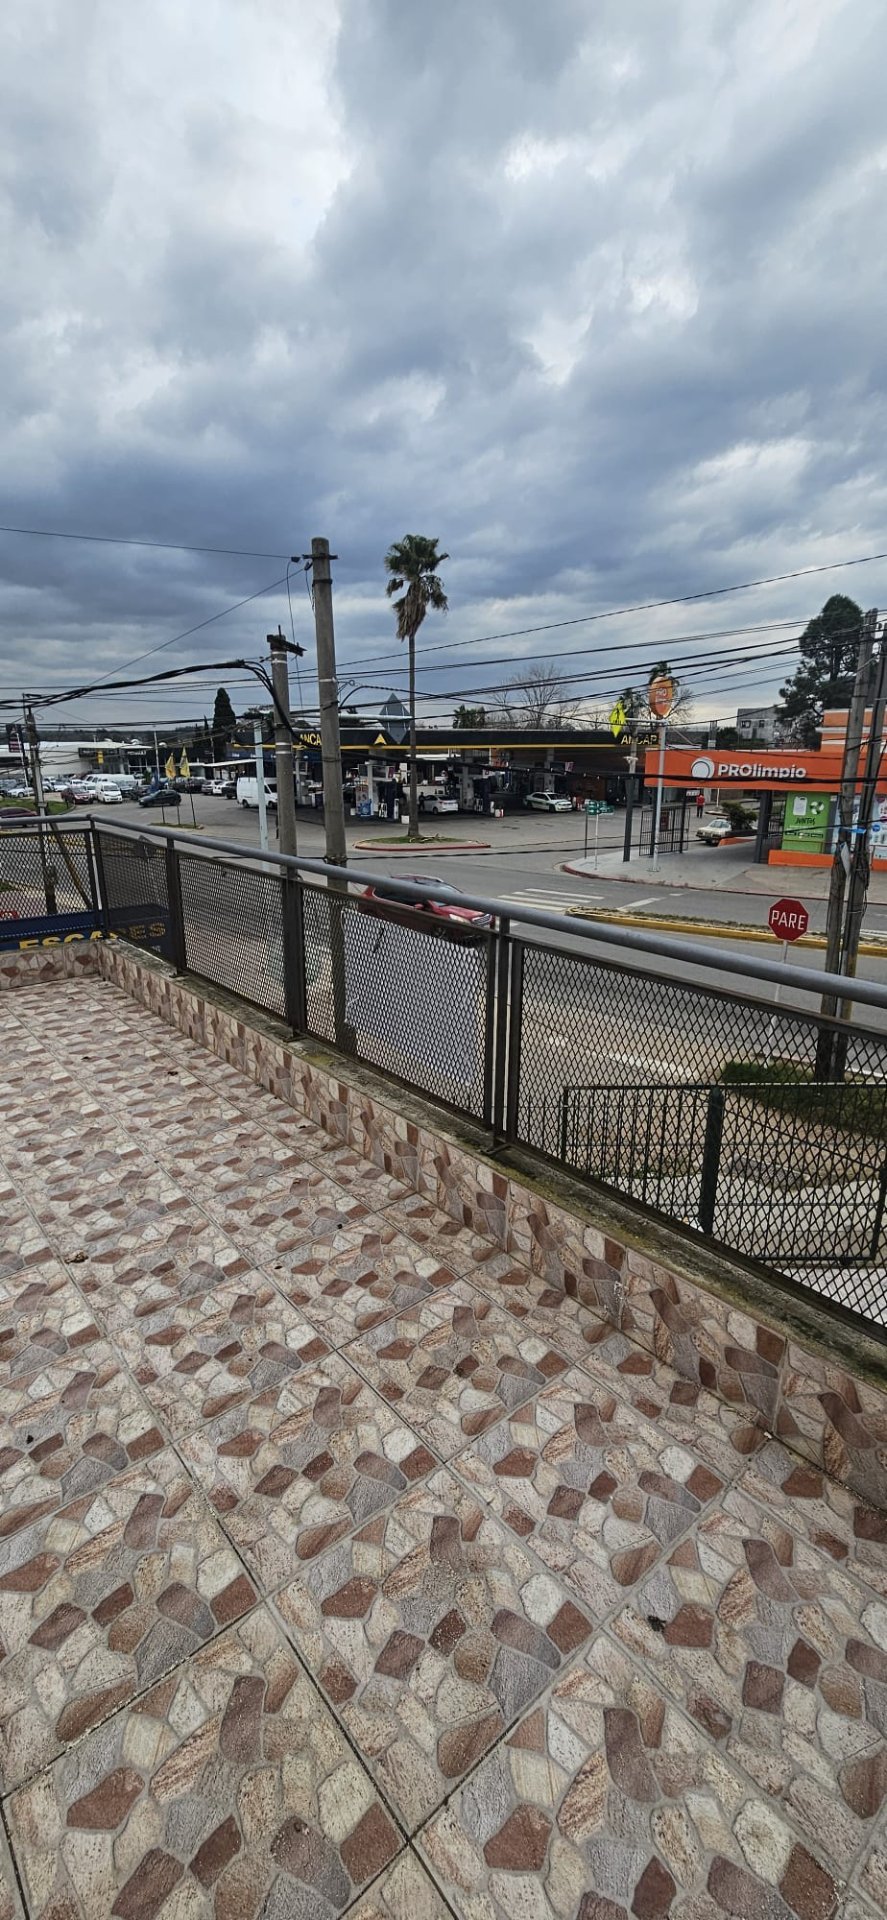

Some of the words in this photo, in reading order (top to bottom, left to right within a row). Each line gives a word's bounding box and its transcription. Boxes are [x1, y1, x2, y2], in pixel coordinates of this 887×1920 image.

[718, 763, 807, 779] PROlimpio
[771, 910, 808, 930] PARE
[19, 922, 166, 950] ESCAES
